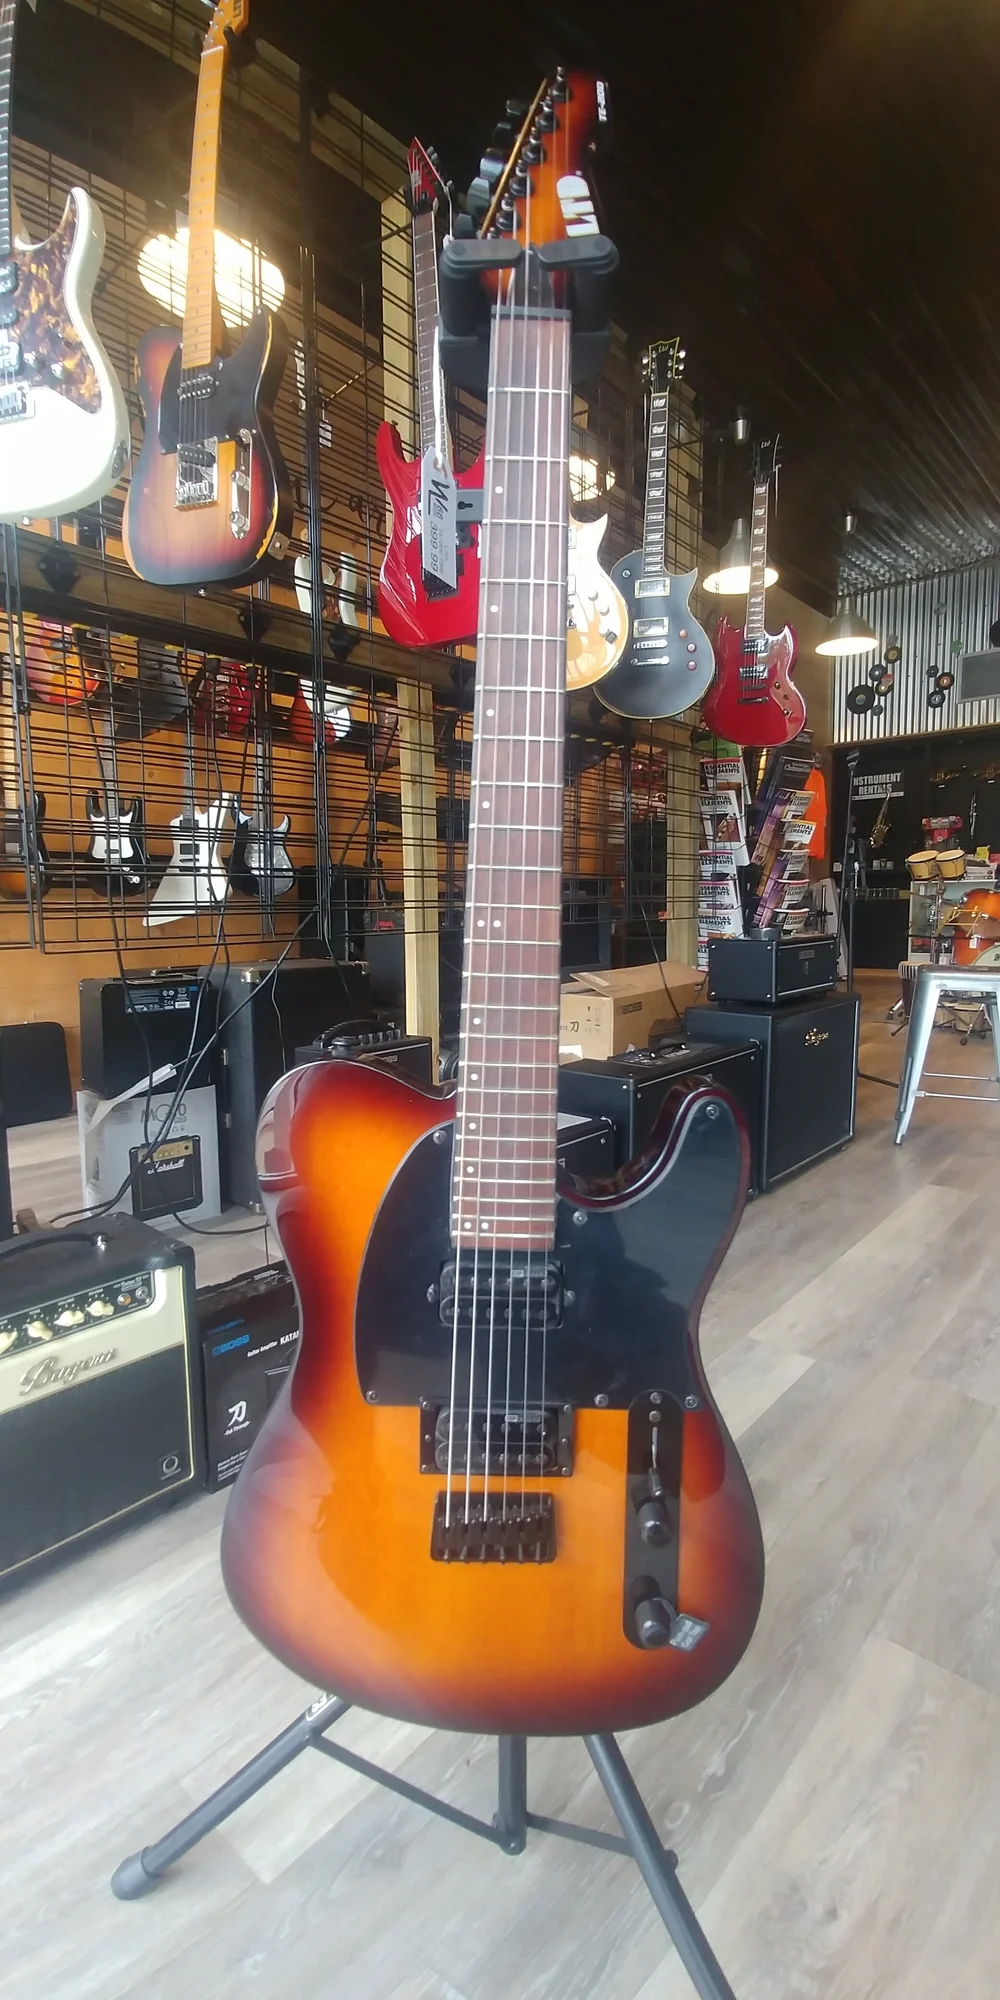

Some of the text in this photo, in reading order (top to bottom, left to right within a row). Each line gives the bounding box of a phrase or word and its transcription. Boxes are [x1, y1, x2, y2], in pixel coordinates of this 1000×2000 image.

[853, 772, 902, 786] NSTRUMENT
[140, 1103, 187, 1123] MG0
[147, 1158, 185, 1174] Marshall
[220, 1334, 250, 1353] BOSS
[228, 1400, 247, 1427] 刀
